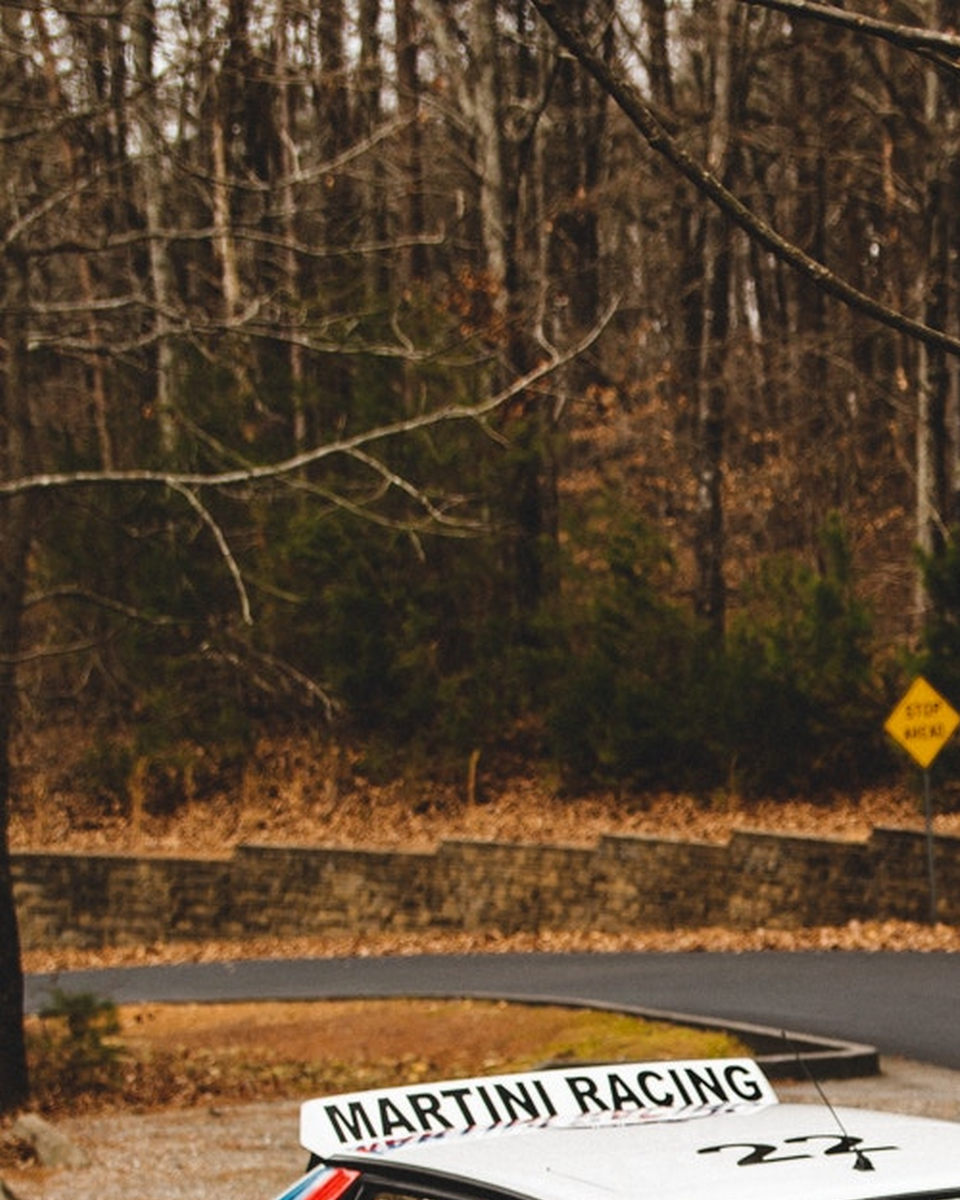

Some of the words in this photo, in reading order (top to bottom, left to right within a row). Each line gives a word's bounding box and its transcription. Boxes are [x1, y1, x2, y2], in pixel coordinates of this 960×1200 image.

[905, 702, 939, 719] STOP
[323, 1080, 557, 1144] MARTINI
[565, 1065, 764, 1115] RACING
[697, 1134, 899, 1166] 22
